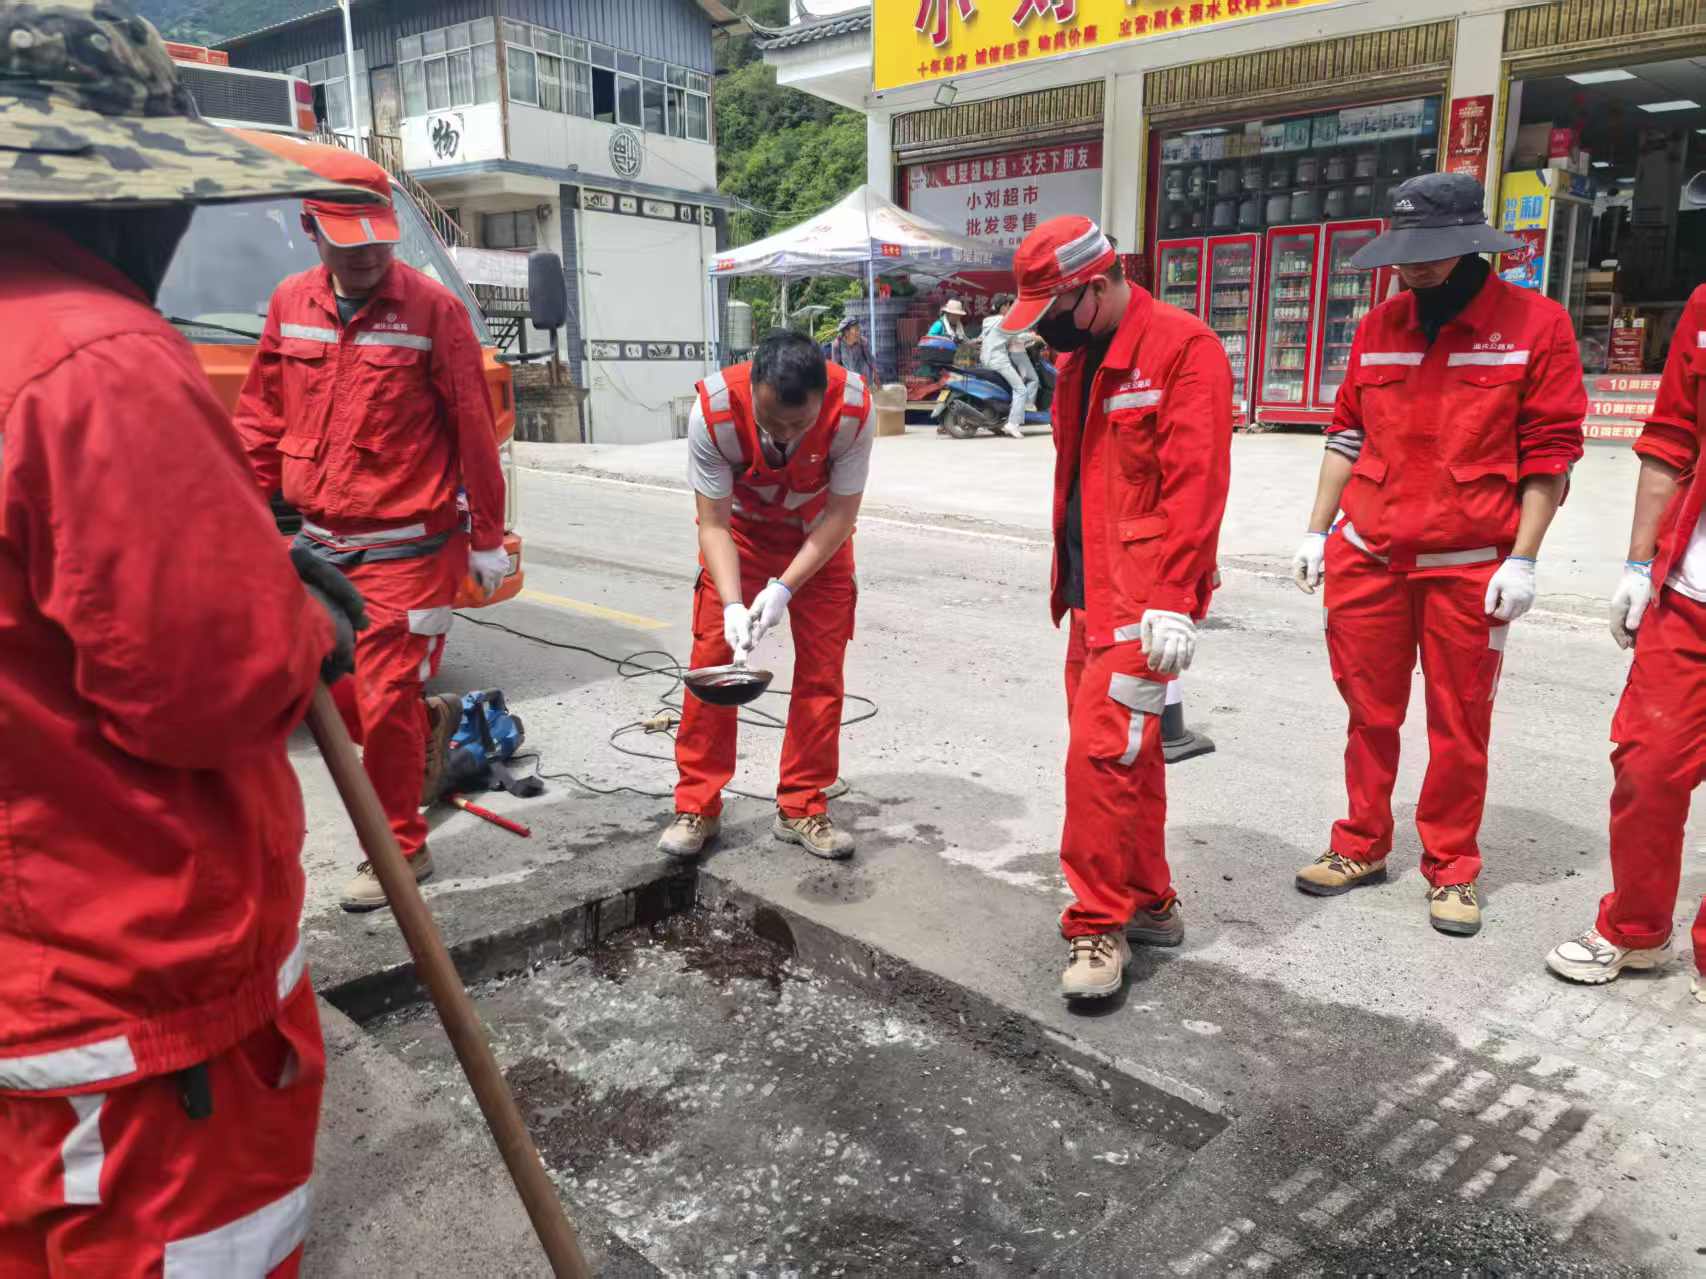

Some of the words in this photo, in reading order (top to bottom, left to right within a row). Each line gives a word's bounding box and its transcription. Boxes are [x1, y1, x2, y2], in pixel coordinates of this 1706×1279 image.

[432, 118, 460, 160] 物
[966, 186, 1039, 211] 小刘超市
[966, 212, 1038, 237] 批发零售
